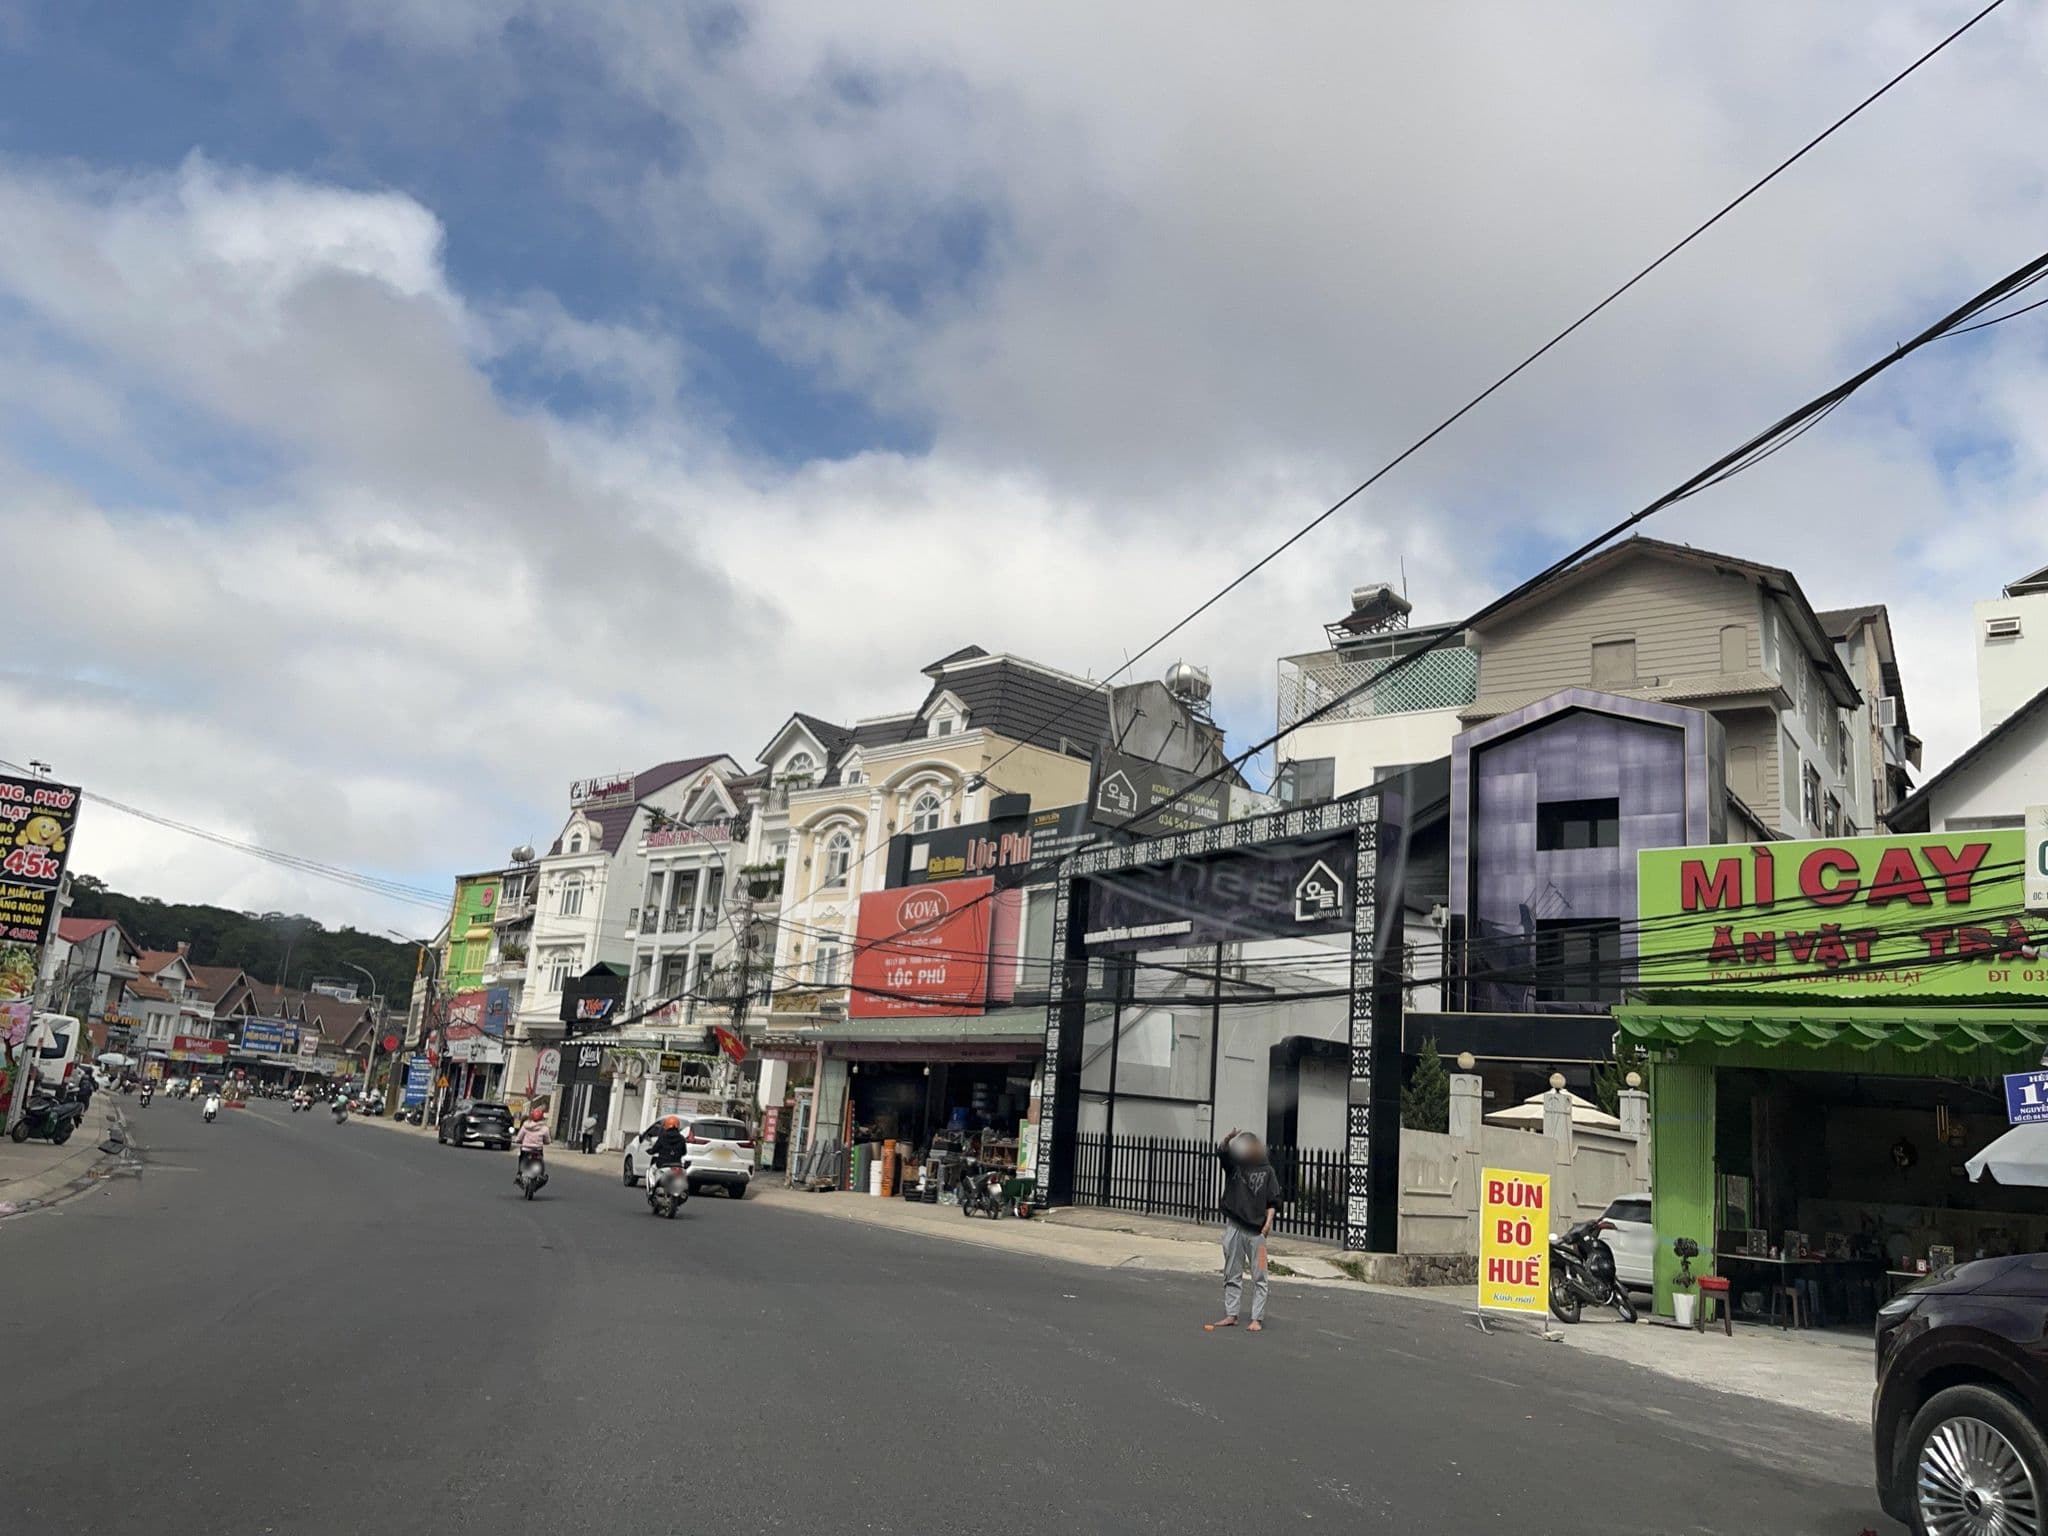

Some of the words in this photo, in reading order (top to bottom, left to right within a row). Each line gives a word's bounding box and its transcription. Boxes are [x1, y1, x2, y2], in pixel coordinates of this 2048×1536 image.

[34, 788, 76, 809] PHỞ
[3, 849, 59, 880] 45K
[966, 838, 998, 875] Lộc
[999, 830, 1032, 866] Phú
[1680, 846, 1775, 911] MÌ
[1798, 842, 1992, 905] CAY
[18, 902, 45, 914] NGON
[1305, 881, 1335, 909] 오늘
[904, 900, 940, 920] KOVA
[1706, 925, 1776, 964] ĂN
[1784, 922, 1879, 968] VẬT
[887, 967, 913, 988] LỘC
[917, 964, 947, 985] PHÚ
[1988, 969, 2011, 983] ĐT
[2022, 969, 2048, 983] 03
[2029, 1073, 2048, 1083] HẺ
[1488, 1177, 1543, 1209] BÚN
[1496, 1215, 1532, 1246] BÒ
[1488, 1253, 1542, 1287] HUẾ
